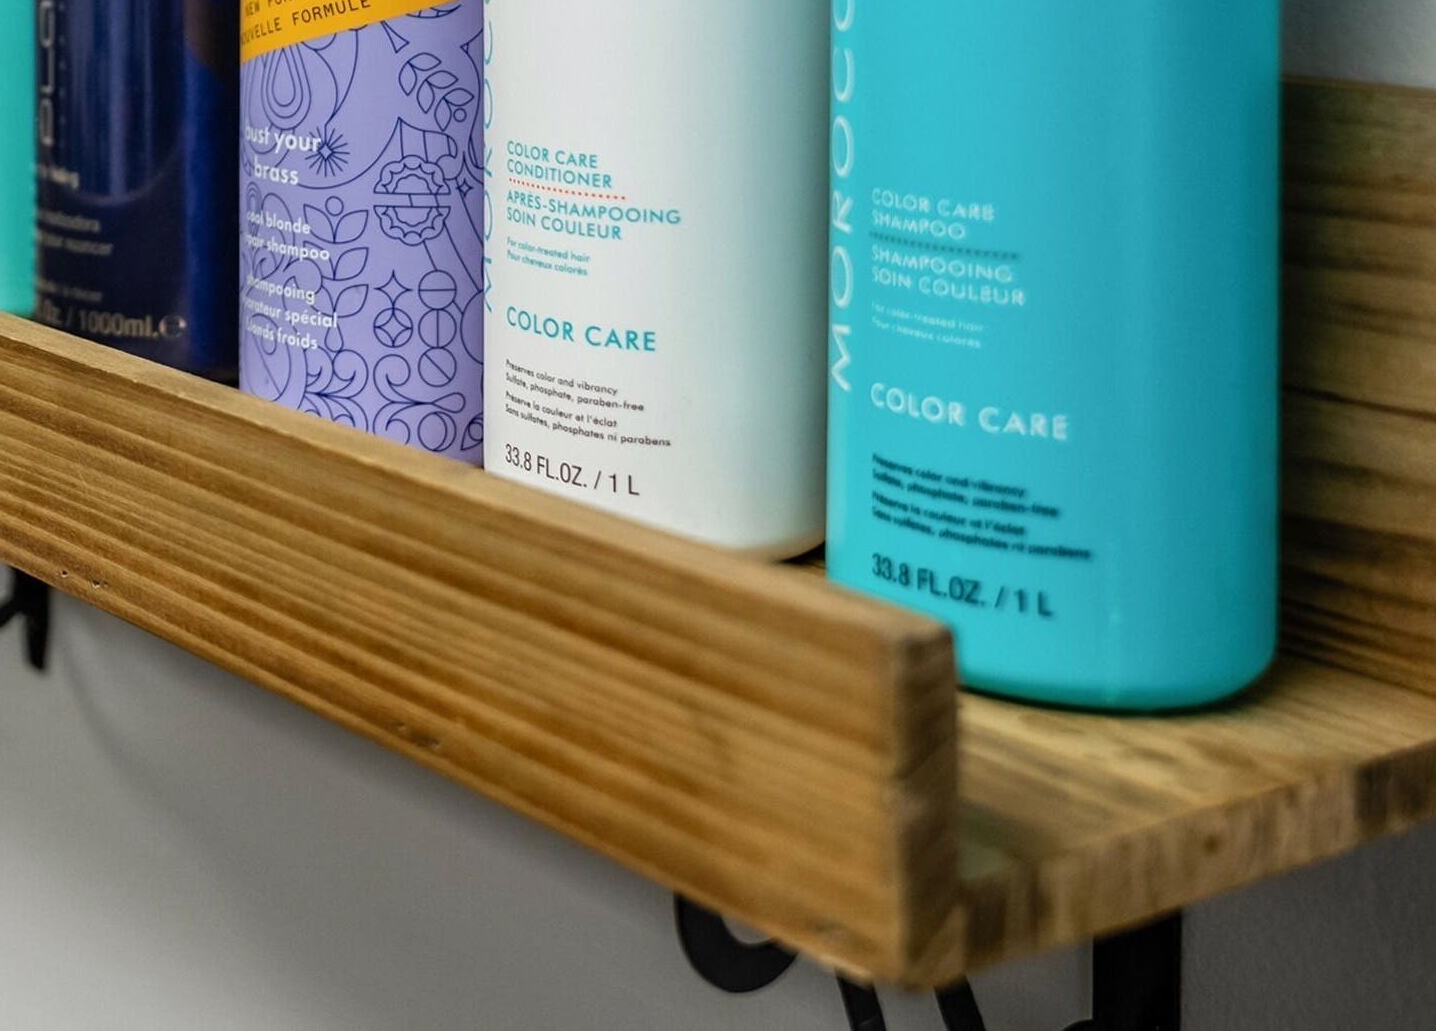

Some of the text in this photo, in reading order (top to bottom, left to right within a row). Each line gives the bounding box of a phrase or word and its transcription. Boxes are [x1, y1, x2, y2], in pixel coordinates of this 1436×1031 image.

[245, 0, 261, 17] NEW
[242, 16, 283, 45] OUVELLE
[274, 131, 322, 154] your
[507, 140, 598, 169] COLOR CARE
[253, 154, 300, 186] brass
[507, 158, 613, 189] CONDITIONER
[506, 189, 682, 225] APRÈS-SHAMPOOING
[871, 187, 996, 222] COLOR CARE
[266, 210, 311, 235] blonde
[506, 206, 622, 240] SOIN COULEUR
[871, 209, 966, 241] SHAMPOO
[266, 236, 331, 262] shampoo
[517, 241, 569, 260] color-treated
[570, 250, 591, 263] hair
[871, 244, 1013, 283] SHAMPOOING
[871, 266, 1026, 307] SOIN COULEUR
[285, 309, 338, 329] spécial
[506, 305, 656, 352] COLOR CARE
[277, 327, 319, 351] froids
[505, 358, 619, 397] Preserves color and vibrancy
[529, 382, 574, 403] phosphate,
[576, 394, 645, 412] paraben-free
[532, 400, 540, 411] la
[541, 403, 573, 420] couleur
[574, 412, 584, 422] et
[870, 381, 1069, 440] COLOR CARE
[505, 403, 520, 417] Sans
[551, 420, 605, 441] phosphates
[607, 432, 618, 442] ni
[620, 433, 672, 447] parabens
[504, 443, 641, 497] 33.8 FL.OZ. / 1 L
[871, 552, 1054, 618] 33.8 FL.OZ. / 1 L
